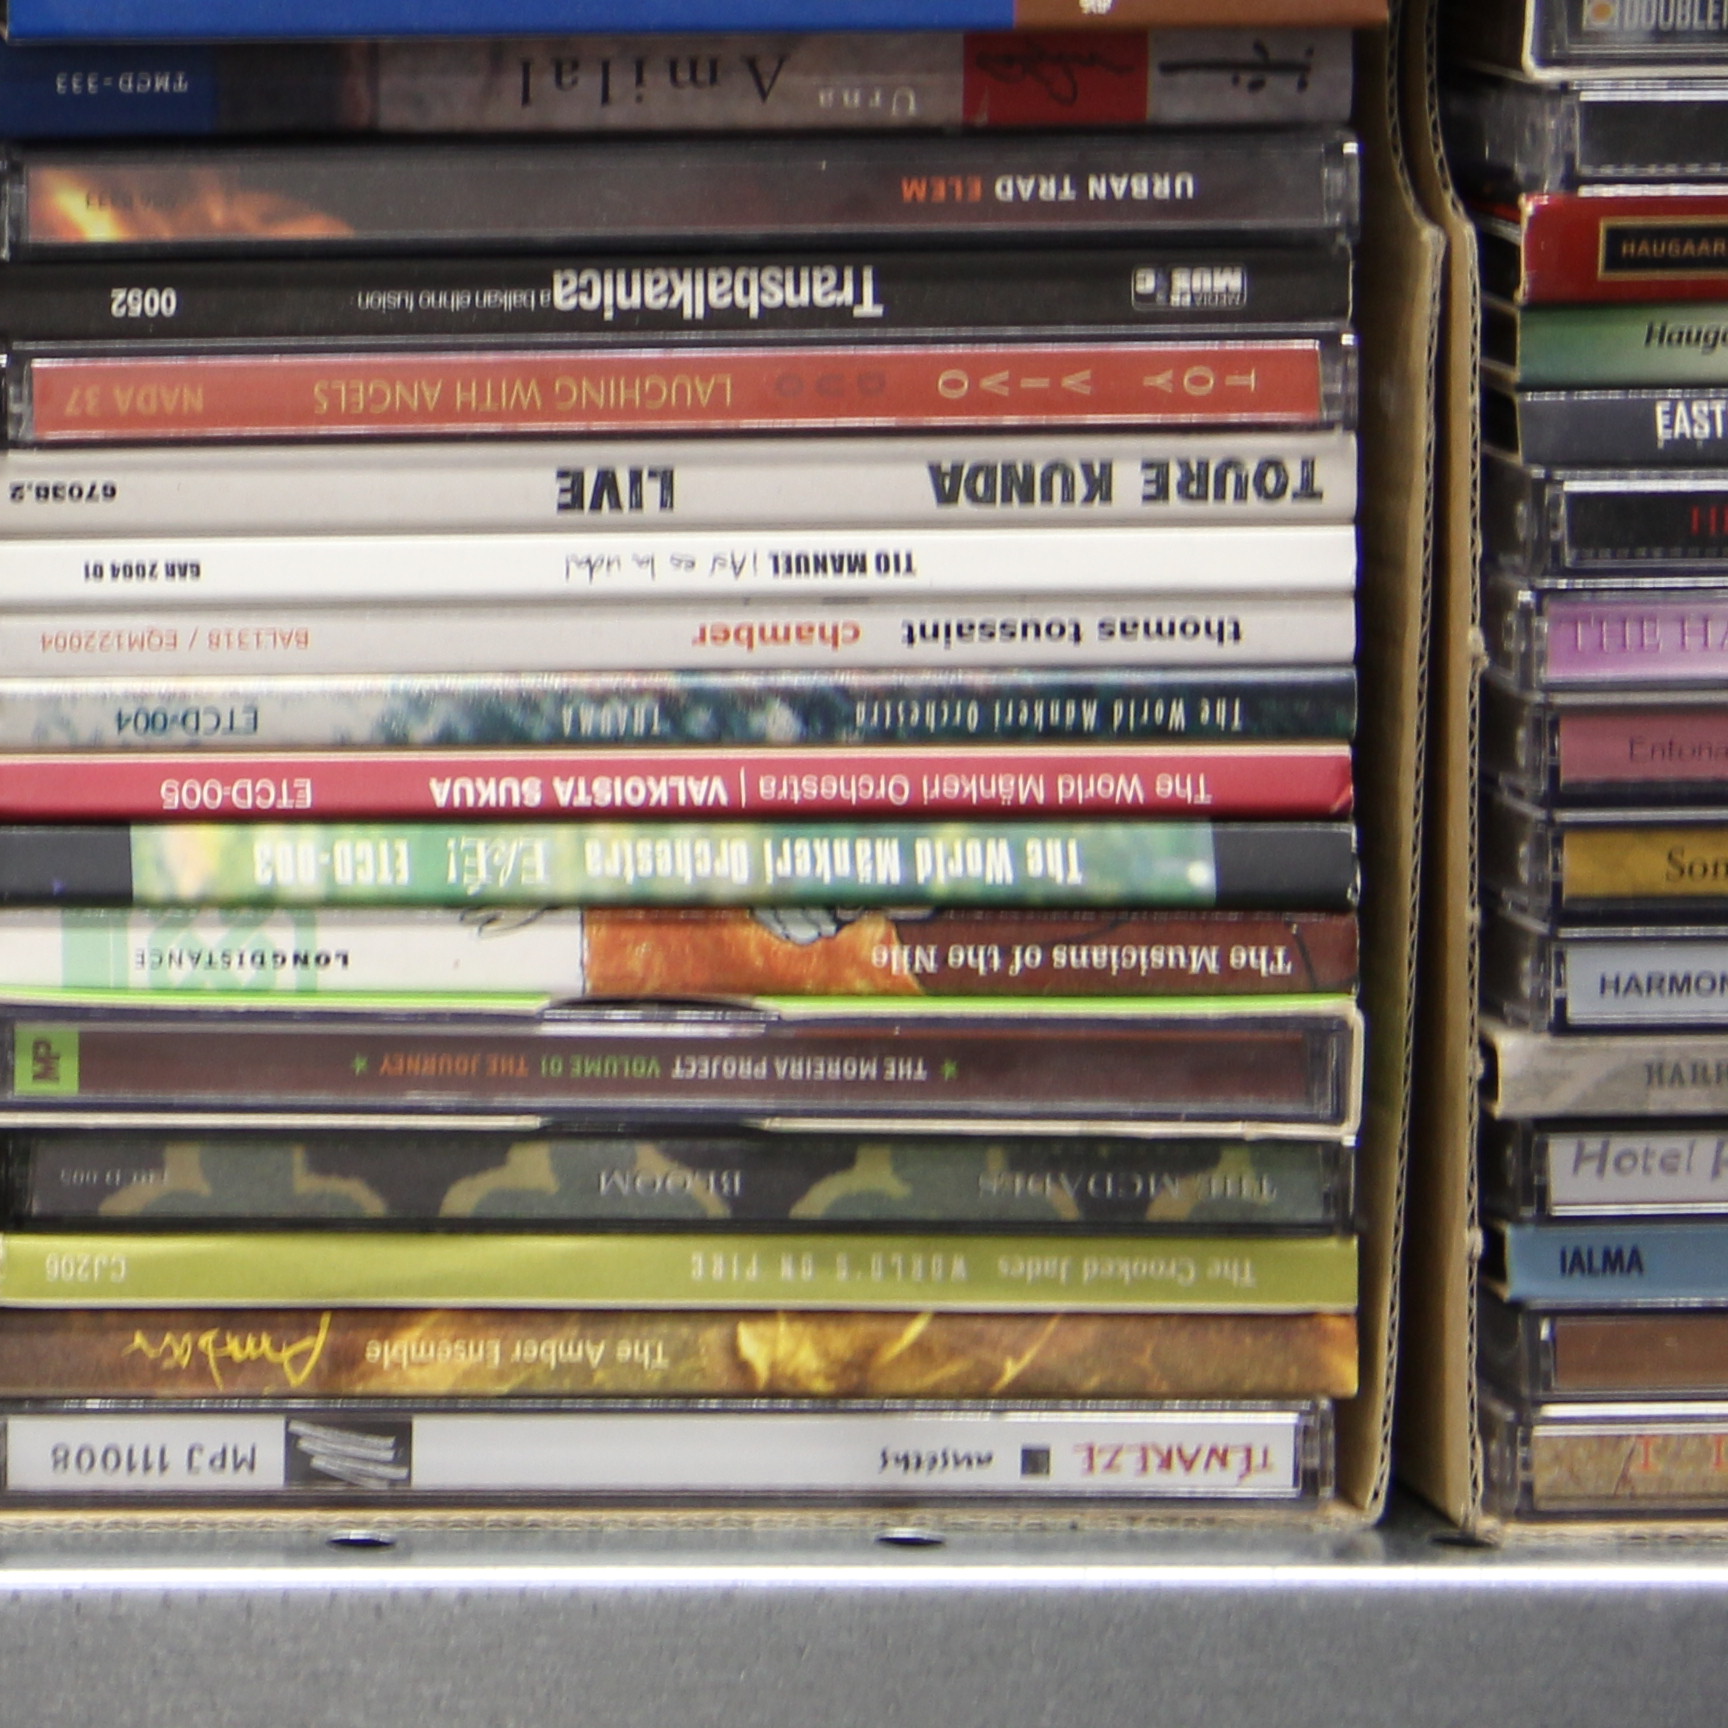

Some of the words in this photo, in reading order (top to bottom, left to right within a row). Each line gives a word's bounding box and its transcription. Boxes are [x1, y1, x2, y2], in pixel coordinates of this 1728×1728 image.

[901, 177, 982, 202] ELEM
[994, 174, 1076, 200] TRAD
[1088, 173, 1193, 199] URBAN
[110, 288, 177, 316] 0052
[553, 264, 883, 318] Transbalkanica
[313, 378, 442, 413] ANGELS
[454, 377, 542, 410] WITH
[553, 373, 732, 410] LAUGHING
[556, 467, 674, 513] LIVE
[927, 459, 1113, 507] KUNDA
[1139, 458, 1322, 503] TOURE
[692, 622, 861, 652] chamber
[902, 618, 1082, 648] toussaint
[1097, 618, 1242, 646] thomas
[429, 777, 542, 807] SUKUA
[552, 776, 728, 806] VALKOISTA
[759, 773, 910, 804] Orchestra
[922, 773, 1045, 804] Mänkeri
[1057, 773, 1146, 804] World
[1156, 773, 1212, 804] The
[870, 944, 938, 974] Nile
[948, 943, 1000, 974] the
[1008, 943, 1042, 974] of
[1053, 942, 1219, 976] Musicians
[1230, 943, 1290, 976] The
[1572, 1138, 1697, 1178] Hotel
[1560, 1246, 1644, 1274] IALMA
[50, 1443, 170, 1473] 111008
[187, 1442, 256, 1473] MPJ
